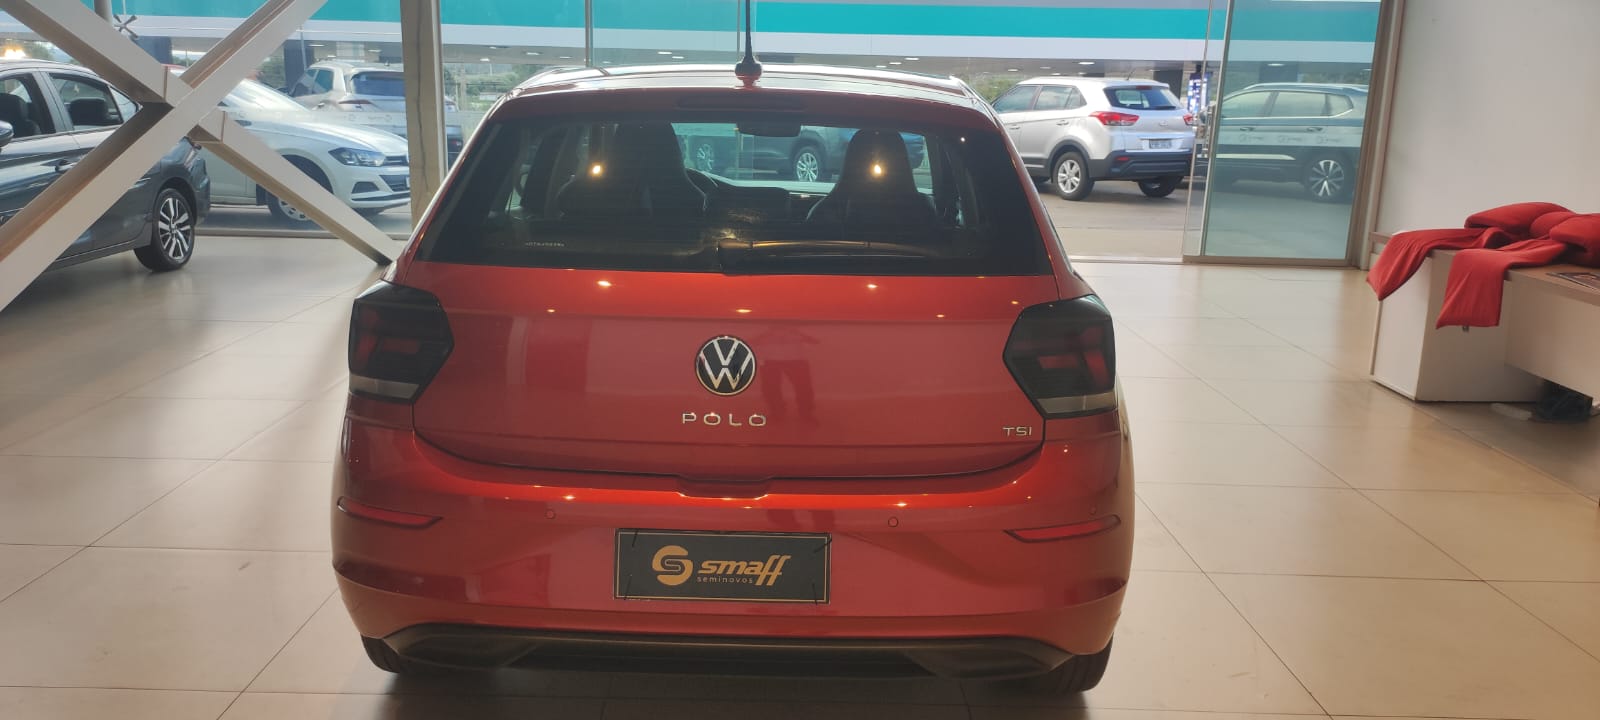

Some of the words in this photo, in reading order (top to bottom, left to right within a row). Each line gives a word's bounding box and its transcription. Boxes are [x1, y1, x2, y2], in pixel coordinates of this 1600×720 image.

[682, 412, 767, 427] POLO
[1002, 426, 1033, 437] TSI
[697, 554, 792, 586] smaff
[697, 576, 753, 584] seminovos
